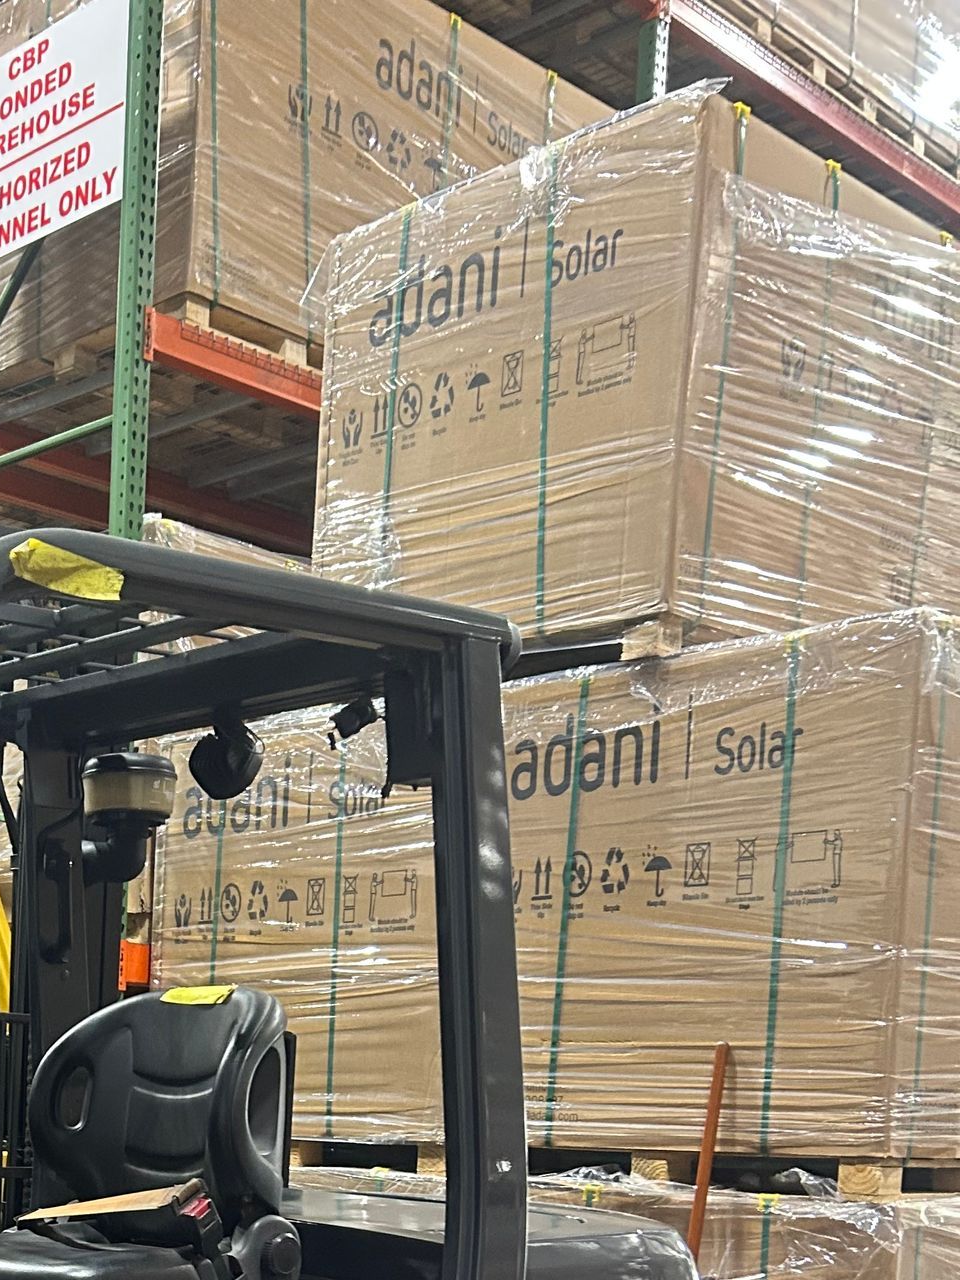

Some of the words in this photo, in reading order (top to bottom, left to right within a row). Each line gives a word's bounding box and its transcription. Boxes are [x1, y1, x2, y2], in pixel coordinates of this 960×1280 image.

[8, 38, 50, 80] CBP
[375, 38, 464, 129] adani
[58, 166, 118, 217] ONLY
[369, 225, 502, 347] adani
[550, 228, 624, 288] Solar
[511, 703, 660, 800] adani
[714, 722, 804, 775] Solar
